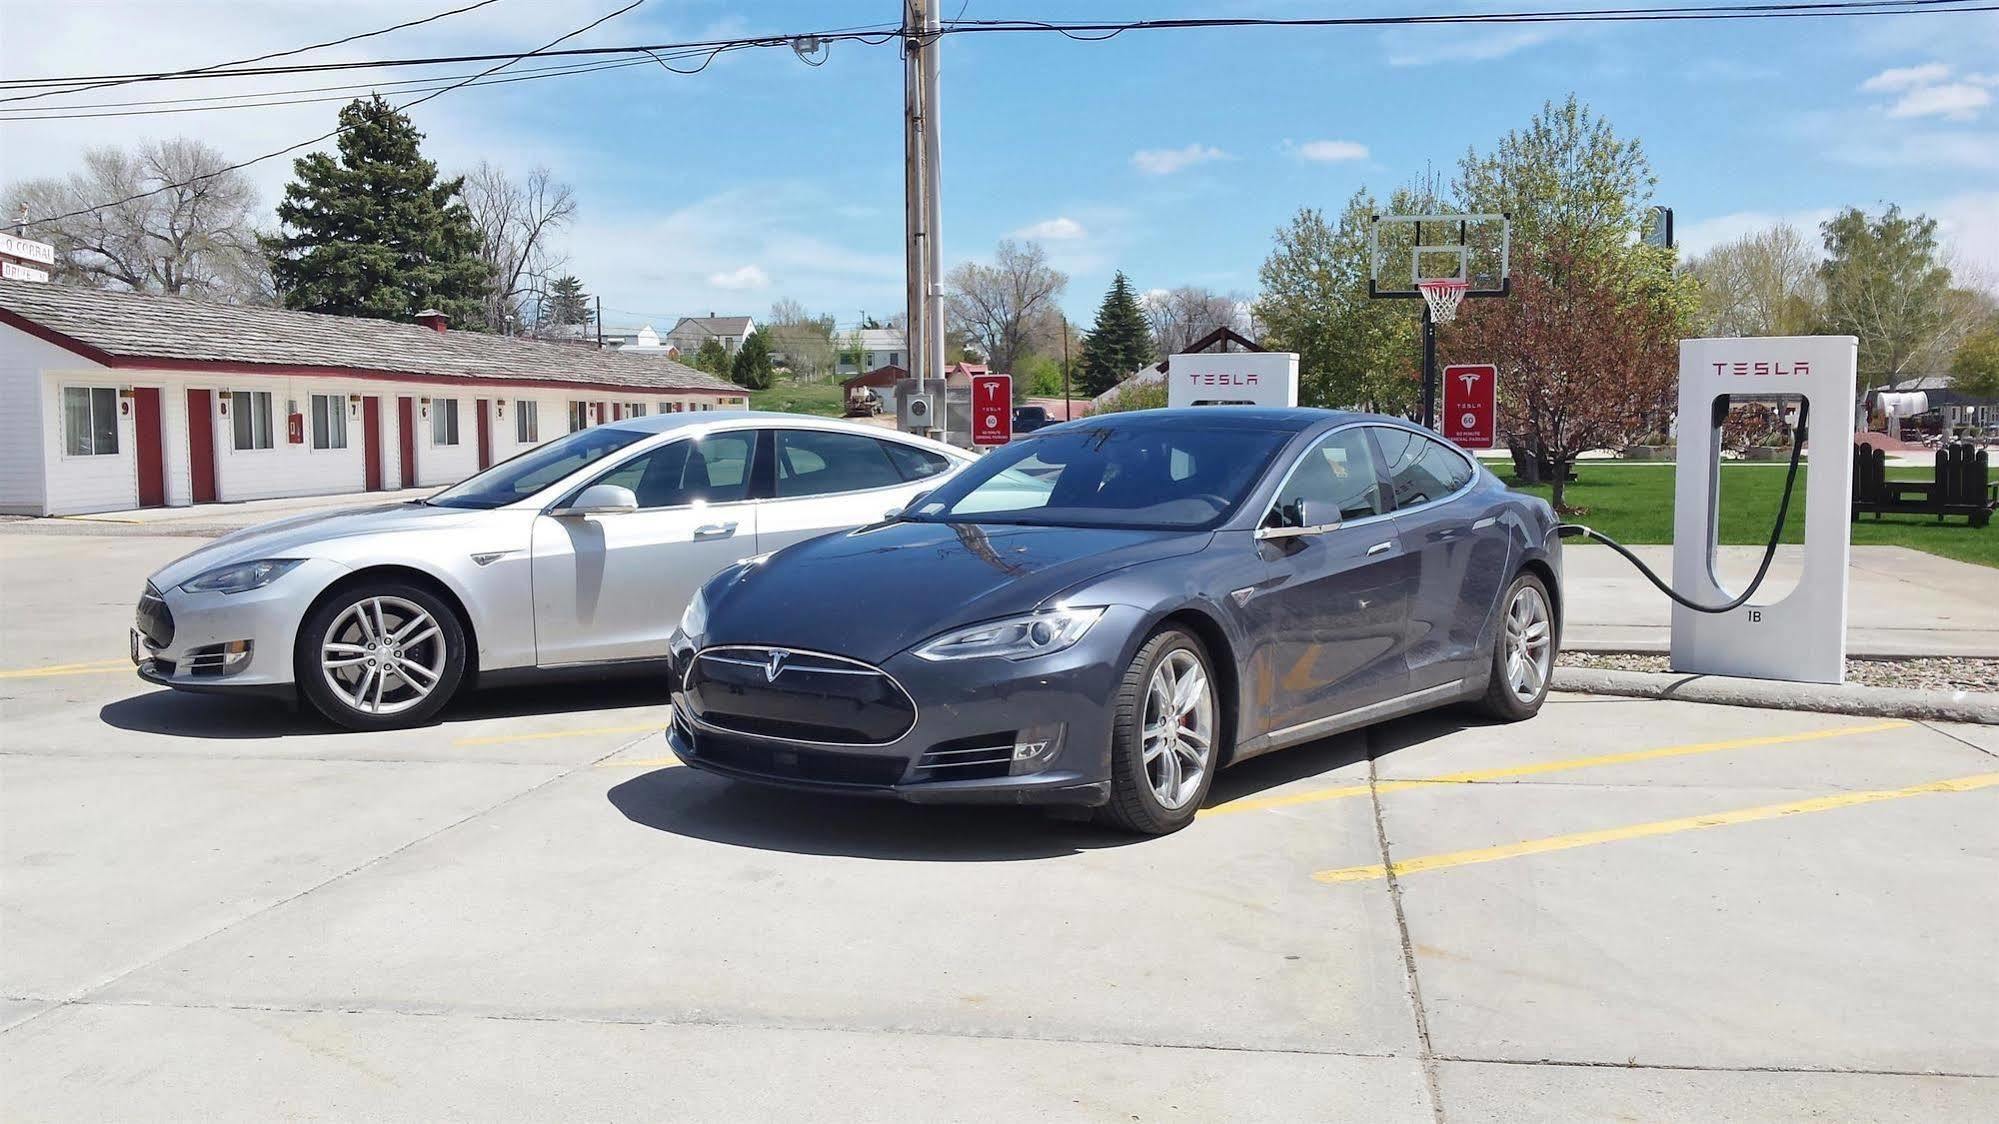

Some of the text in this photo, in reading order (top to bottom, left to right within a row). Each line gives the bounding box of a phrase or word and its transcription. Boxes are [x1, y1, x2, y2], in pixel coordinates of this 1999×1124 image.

[1712, 362, 1809, 376] TESLA
[1189, 374, 1258, 385] TESLA
[122, 402, 129, 415] 9
[220, 403, 227, 415] 8
[351, 404, 357, 415] 7
[422, 407, 427, 417] 6
[1463, 416, 1474, 424] 60
[1748, 610, 1761, 622] 1B
